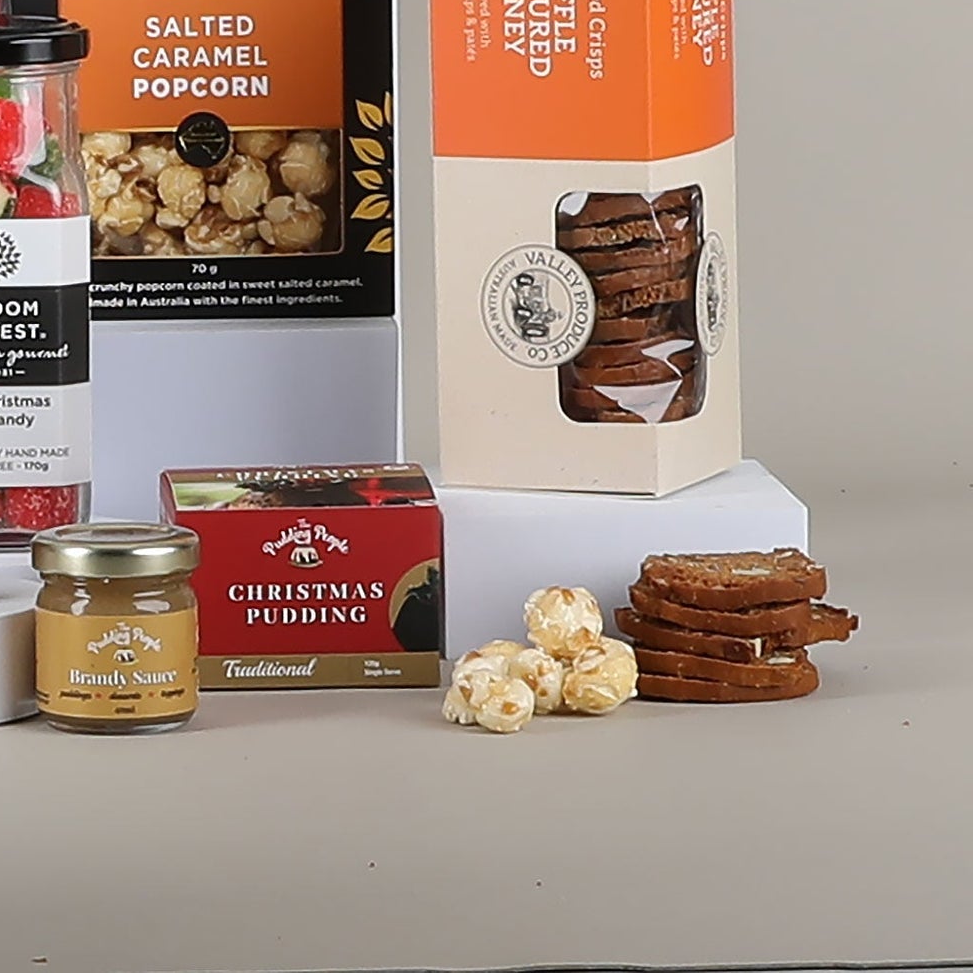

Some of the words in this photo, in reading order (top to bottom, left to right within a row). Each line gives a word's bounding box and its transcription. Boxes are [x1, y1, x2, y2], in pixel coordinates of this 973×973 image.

[145, 15, 254, 38] SALTED
[479, 19, 491, 48] with
[133, 46, 268, 69] CARAMEL
[585, 17, 607, 80] Crisps
[133, 75, 270, 100] POPCORN
[192, 263, 208, 275] 70
[209, 264, 219, 276] g
[525, 251, 583, 288] VALLEY
[137, 281, 184, 293] popcorn
[187, 279, 226, 290] coated
[229, 279, 240, 289] in
[242, 279, 275, 290] sweet
[278, 278, 313, 289] salted
[127, 297, 138, 307] in
[140, 296, 190, 307] Australia
[192, 295, 219, 306] with
[220, 294, 239, 306] the
[241, 294, 274, 305] finest
[549, 290, 589, 359] PRODUCE
[6, 343, 69, 366] gourmet
[5, 447, 37, 459] HAND
[39, 446, 70, 458] MADE
[261, 527, 312, 556] Pudding
[313, 524, 350, 554] People
[227, 582, 385, 602] CHRISTMAS
[245, 606, 368, 625] PUDDING
[69, 668, 128, 689] Brandy
[132, 670, 178, 685] Sauce
[222, 657, 318, 679] Traditional
